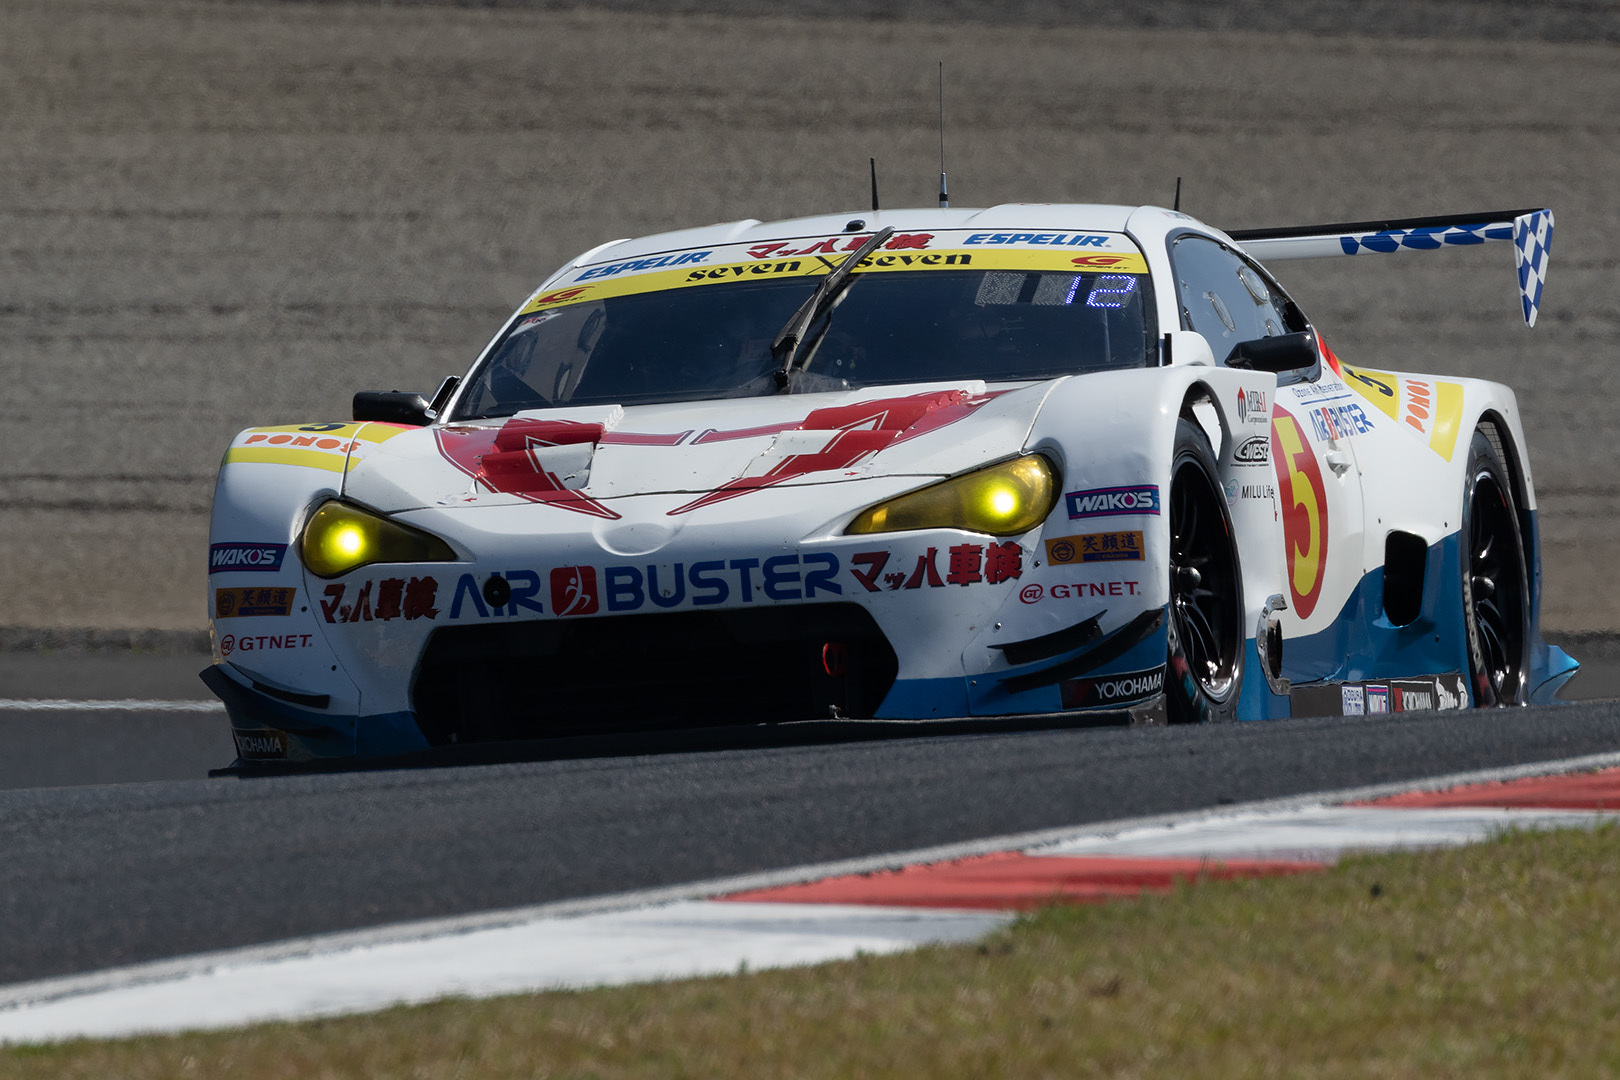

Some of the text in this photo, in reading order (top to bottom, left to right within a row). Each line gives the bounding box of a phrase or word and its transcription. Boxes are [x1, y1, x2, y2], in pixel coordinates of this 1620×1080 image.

[962, 233, 1104, 247] ESPELIR
[573, 251, 712, 282] ESPELIR
[685, 261, 801, 282] seven
[854, 253, 971, 268] seven
[1342, 365, 1394, 397] 5
[1405, 379, 1430, 434] PONOS
[244, 435, 362, 453] PONOS
[1242, 485, 1261, 499] MILU
[1272, 416, 1320, 596] 5
[1082, 532, 1140, 552] 笑顔道
[850, 541, 1023, 593] マッハ車検
[241, 589, 289, 605] 笑顔道
[320, 576, 440, 623] マッハ車検
[449, 552, 843, 619] AR BUSTER
[1050, 581, 1139, 598] GTNET
[239, 634, 312, 651] GTNET
[1095, 672, 1162, 699] YOKOHAMA
